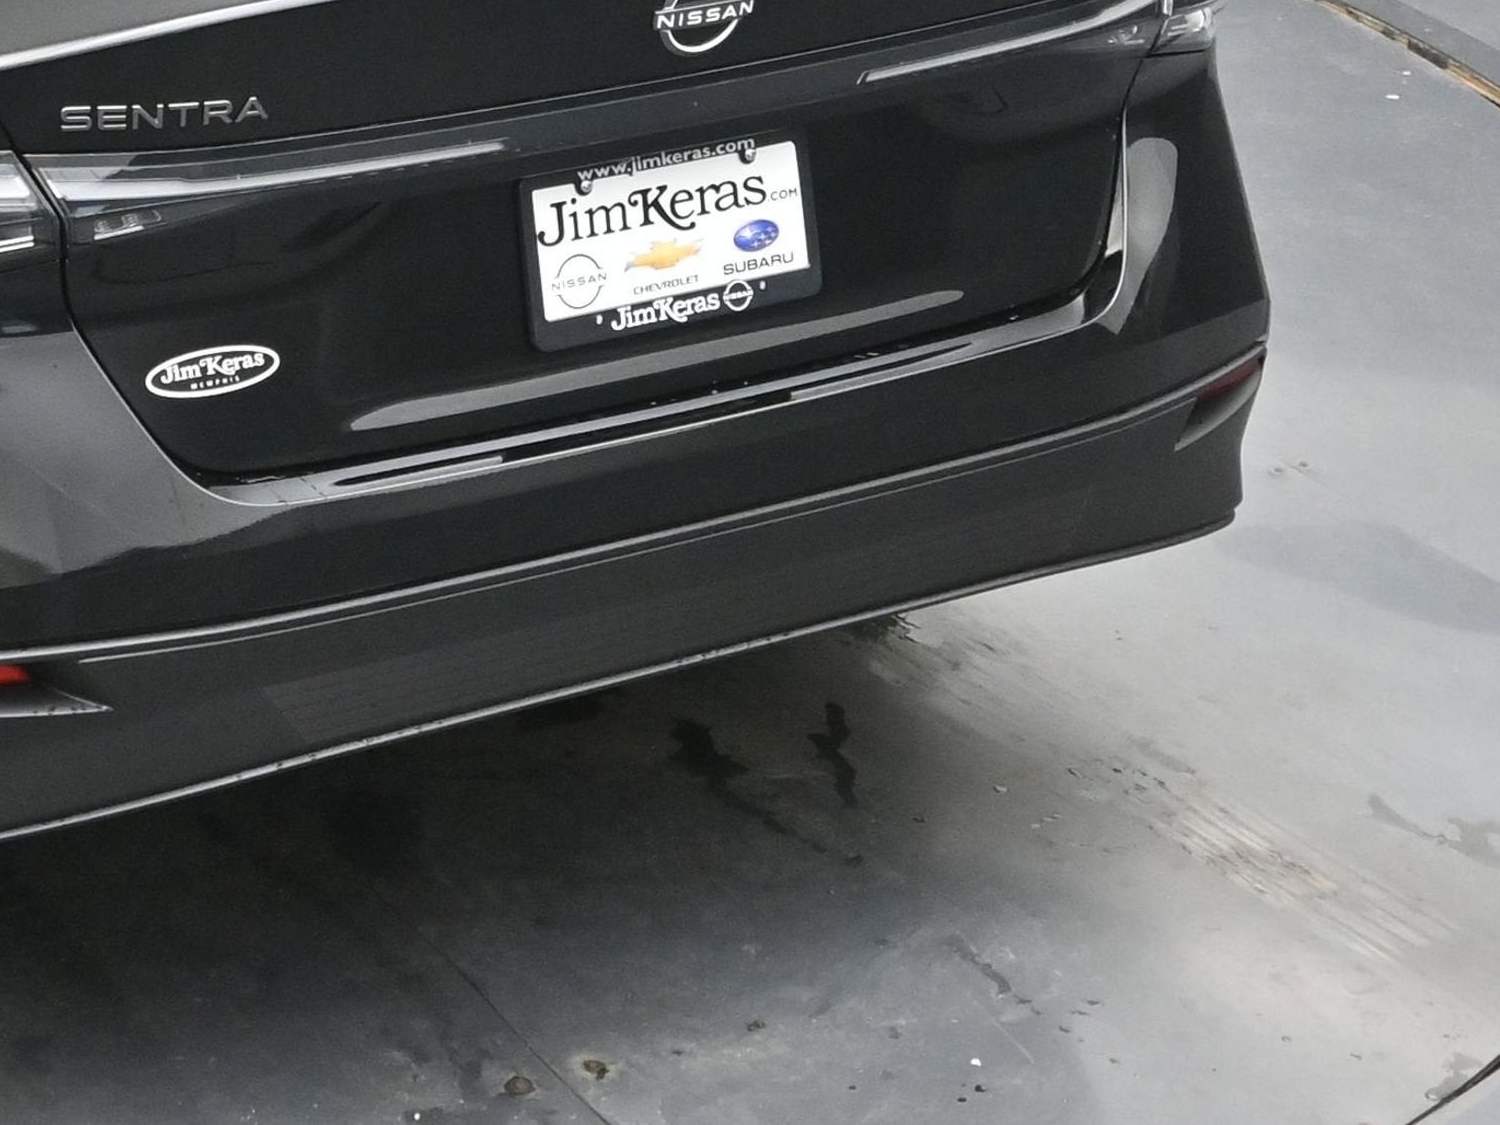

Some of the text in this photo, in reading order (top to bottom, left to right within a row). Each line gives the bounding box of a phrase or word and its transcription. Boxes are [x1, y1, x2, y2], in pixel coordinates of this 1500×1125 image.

[657, 0, 754, 29] NISSAN
[60, 96, 268, 132] SENTRA
[577, 137, 755, 181] www.jimkeras.com
[723, 251, 794, 276] SUBARU
[551, 272, 607, 291] NISSAN
[633, 274, 699, 295] CHEVROLET
